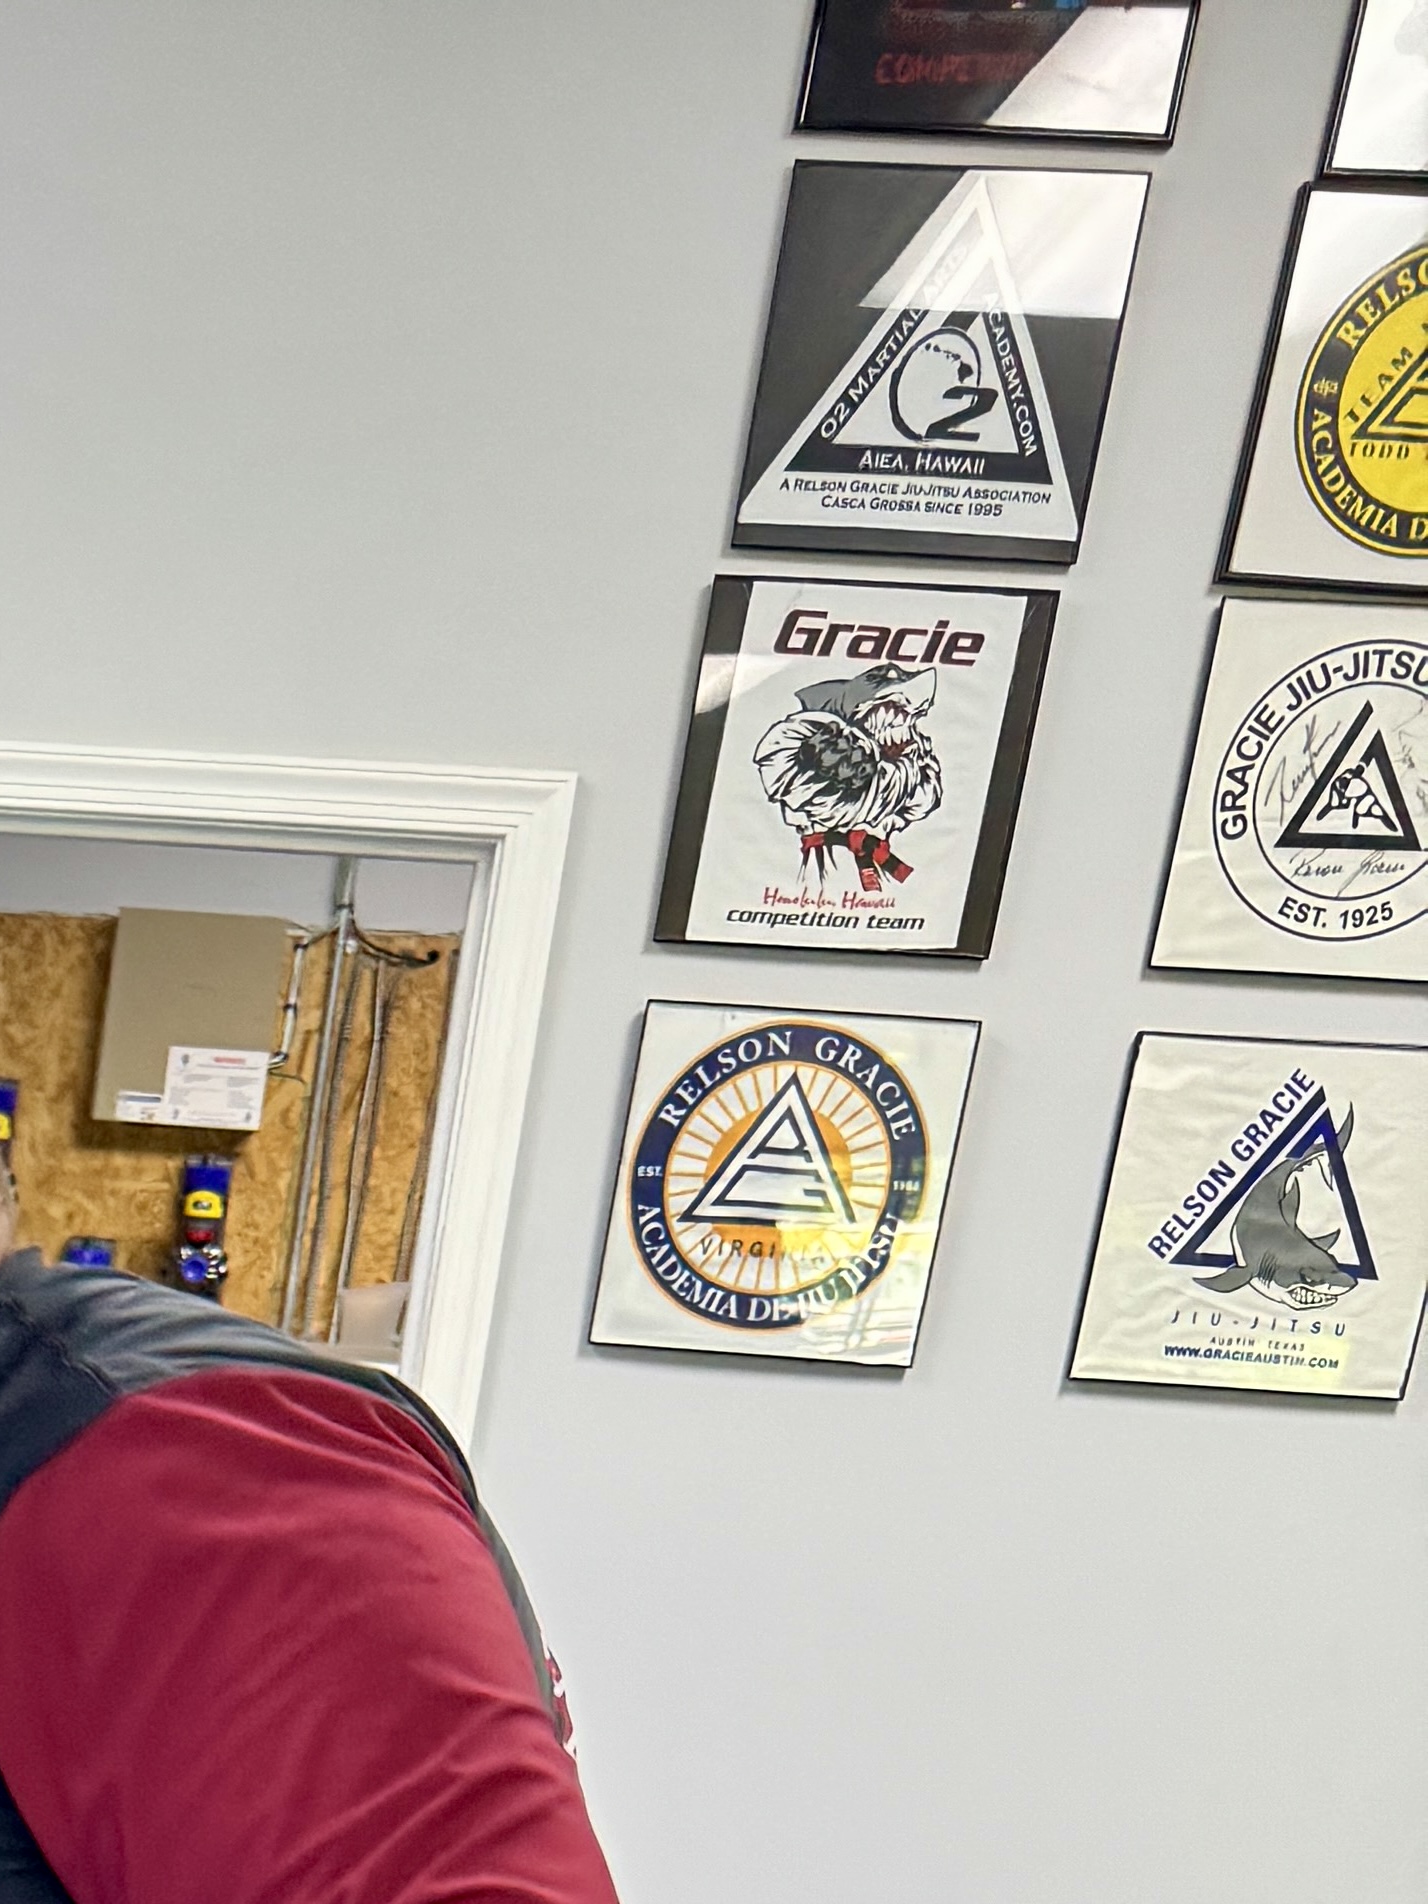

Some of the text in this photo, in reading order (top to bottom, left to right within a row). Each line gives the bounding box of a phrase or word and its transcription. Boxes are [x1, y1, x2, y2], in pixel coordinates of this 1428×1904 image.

[848, 309, 923, 402] MARTIAL
[794, 479, 846, 493] RELSON
[850, 480, 898, 495] GRACIE
[963, 486, 1051, 504] ASSOCIATION
[915, 452, 986, 476] HAWAII
[1313, 409, 1398, 540] ACADEMIA
[968, 502, 1003, 518] 1995
[772, 608, 985, 667] Gracie
[1220, 703, 1285, 841] GRACIE
[726, 909, 925, 931] competition team
[1277, 895, 1394, 930] EST. 1925
[658, 1031, 917, 1141] RELSON GRACIE
[1148, 1068, 1315, 1260] RELSON GRACIE
[637, 1204, 739, 1320] ACADEMIA
[700, 1237, 826, 1265] VIRGI
